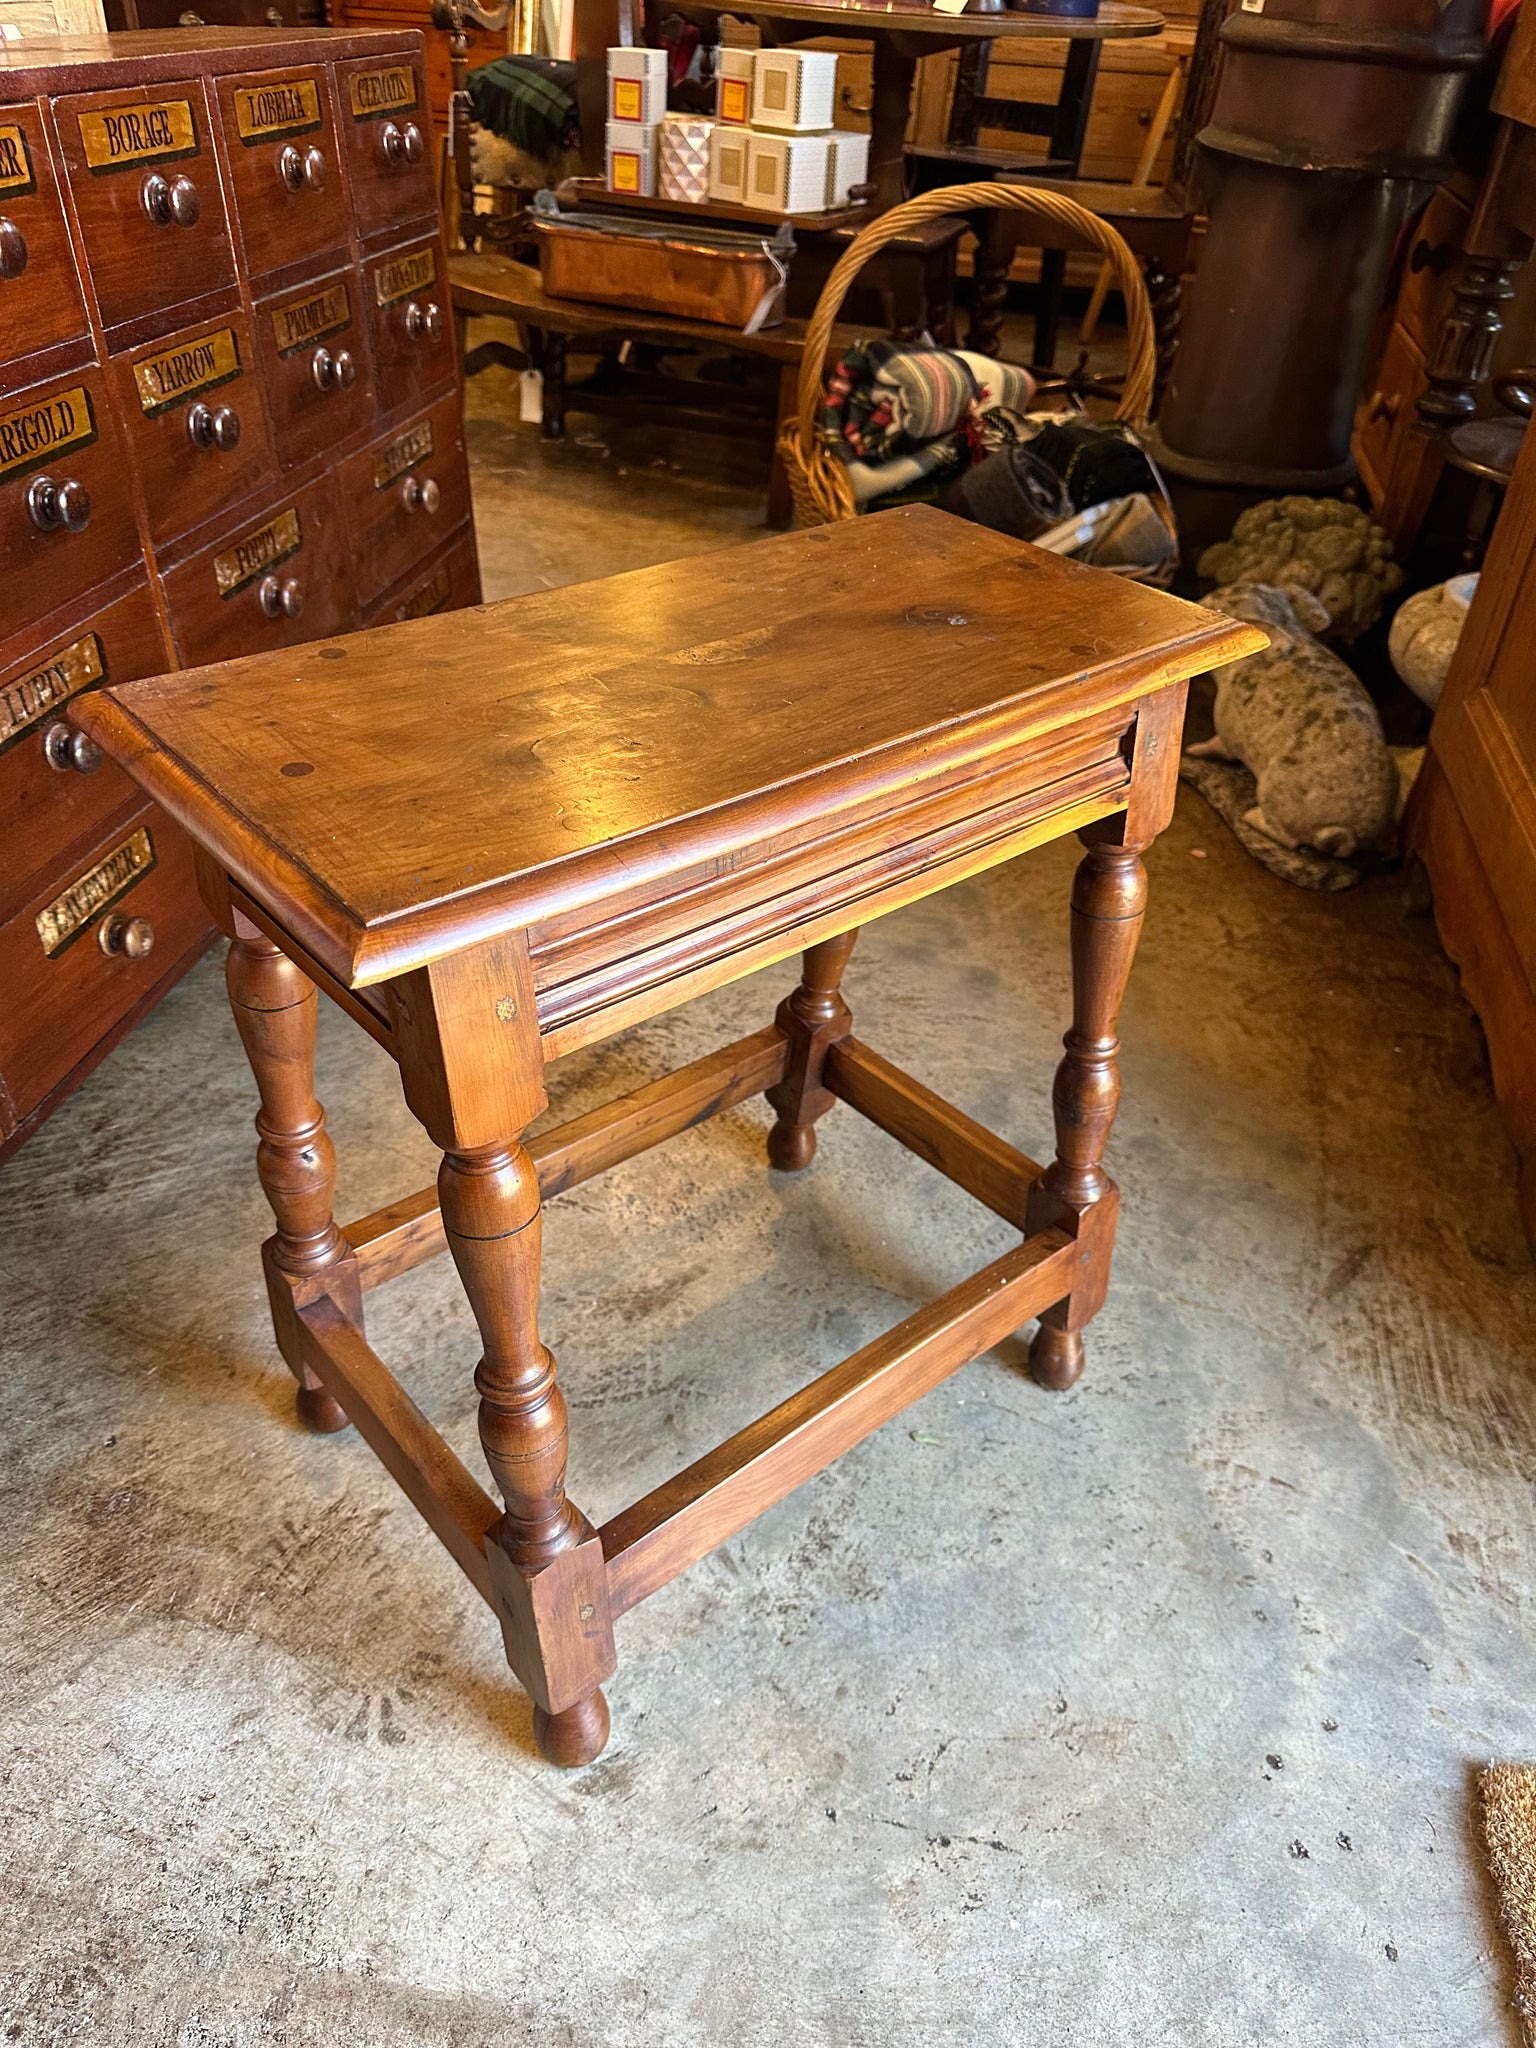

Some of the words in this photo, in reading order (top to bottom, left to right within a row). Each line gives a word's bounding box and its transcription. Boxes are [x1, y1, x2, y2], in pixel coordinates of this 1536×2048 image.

[247, 88, 306, 128] LOBELIA
[357, 73, 406, 108] CLEMATIS
[102, 110, 174, 156] BORAGE
[151, 342, 215, 394] YARROW
[236, 527, 278, 575] POPPY
[2, 661, 70, 727] LUPIN
[51, 846, 139, 935] LAVENDER
